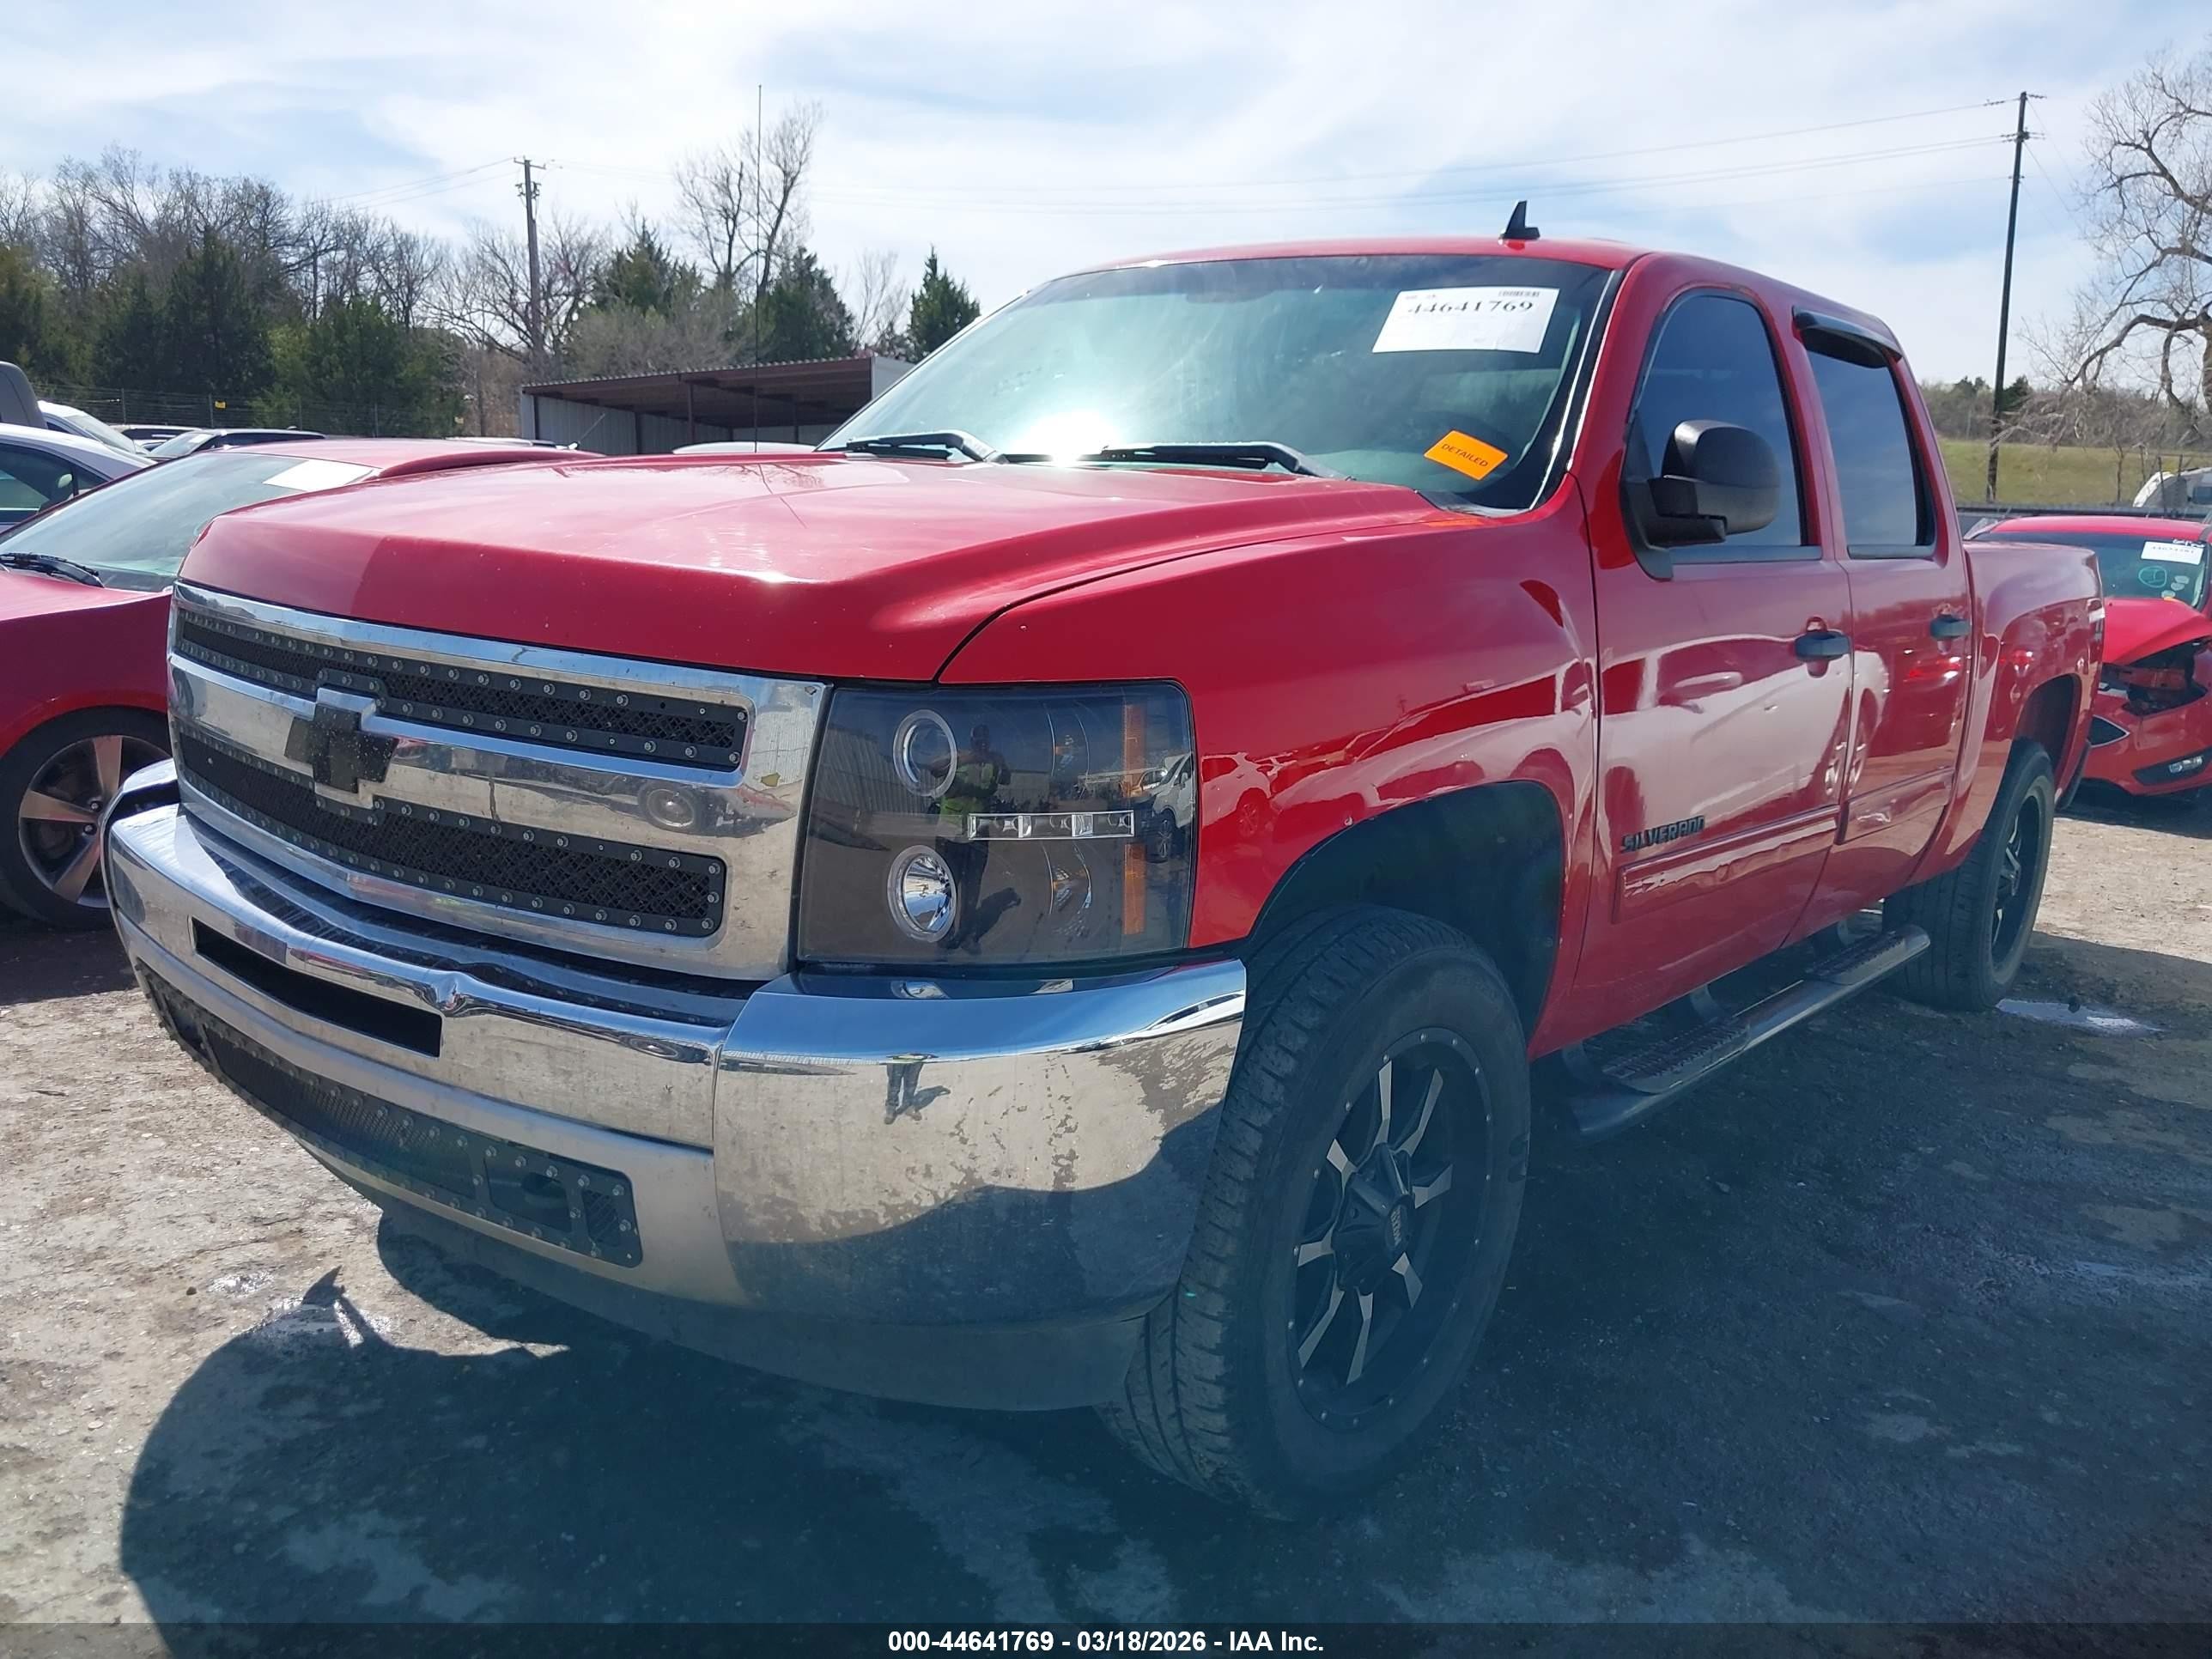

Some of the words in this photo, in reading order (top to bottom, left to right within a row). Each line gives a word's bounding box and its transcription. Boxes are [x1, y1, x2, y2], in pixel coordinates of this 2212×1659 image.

[1408, 301, 1534, 314] 44641769
[1442, 443, 1489, 467] DETAILED
[1622, 816, 1705, 852] SILVERADO
